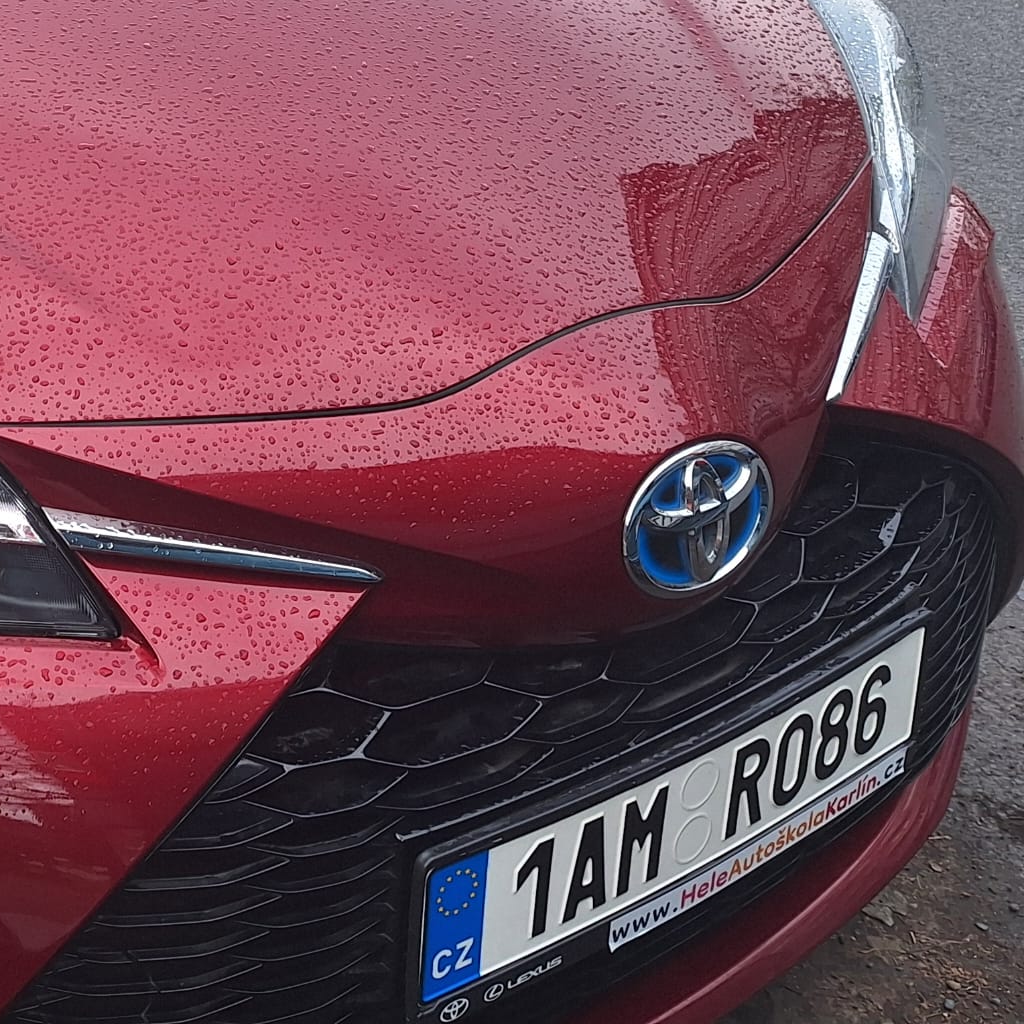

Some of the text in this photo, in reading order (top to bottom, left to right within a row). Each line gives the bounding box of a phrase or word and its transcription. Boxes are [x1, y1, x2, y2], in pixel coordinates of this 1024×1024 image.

[513, 783, 669, 937] 1AM
[611, 756, 905, 943] www.HeleAutoškolaKarlín.cz
[432, 936, 475, 979] CZ
[507, 955, 562, 989] LEXUS
